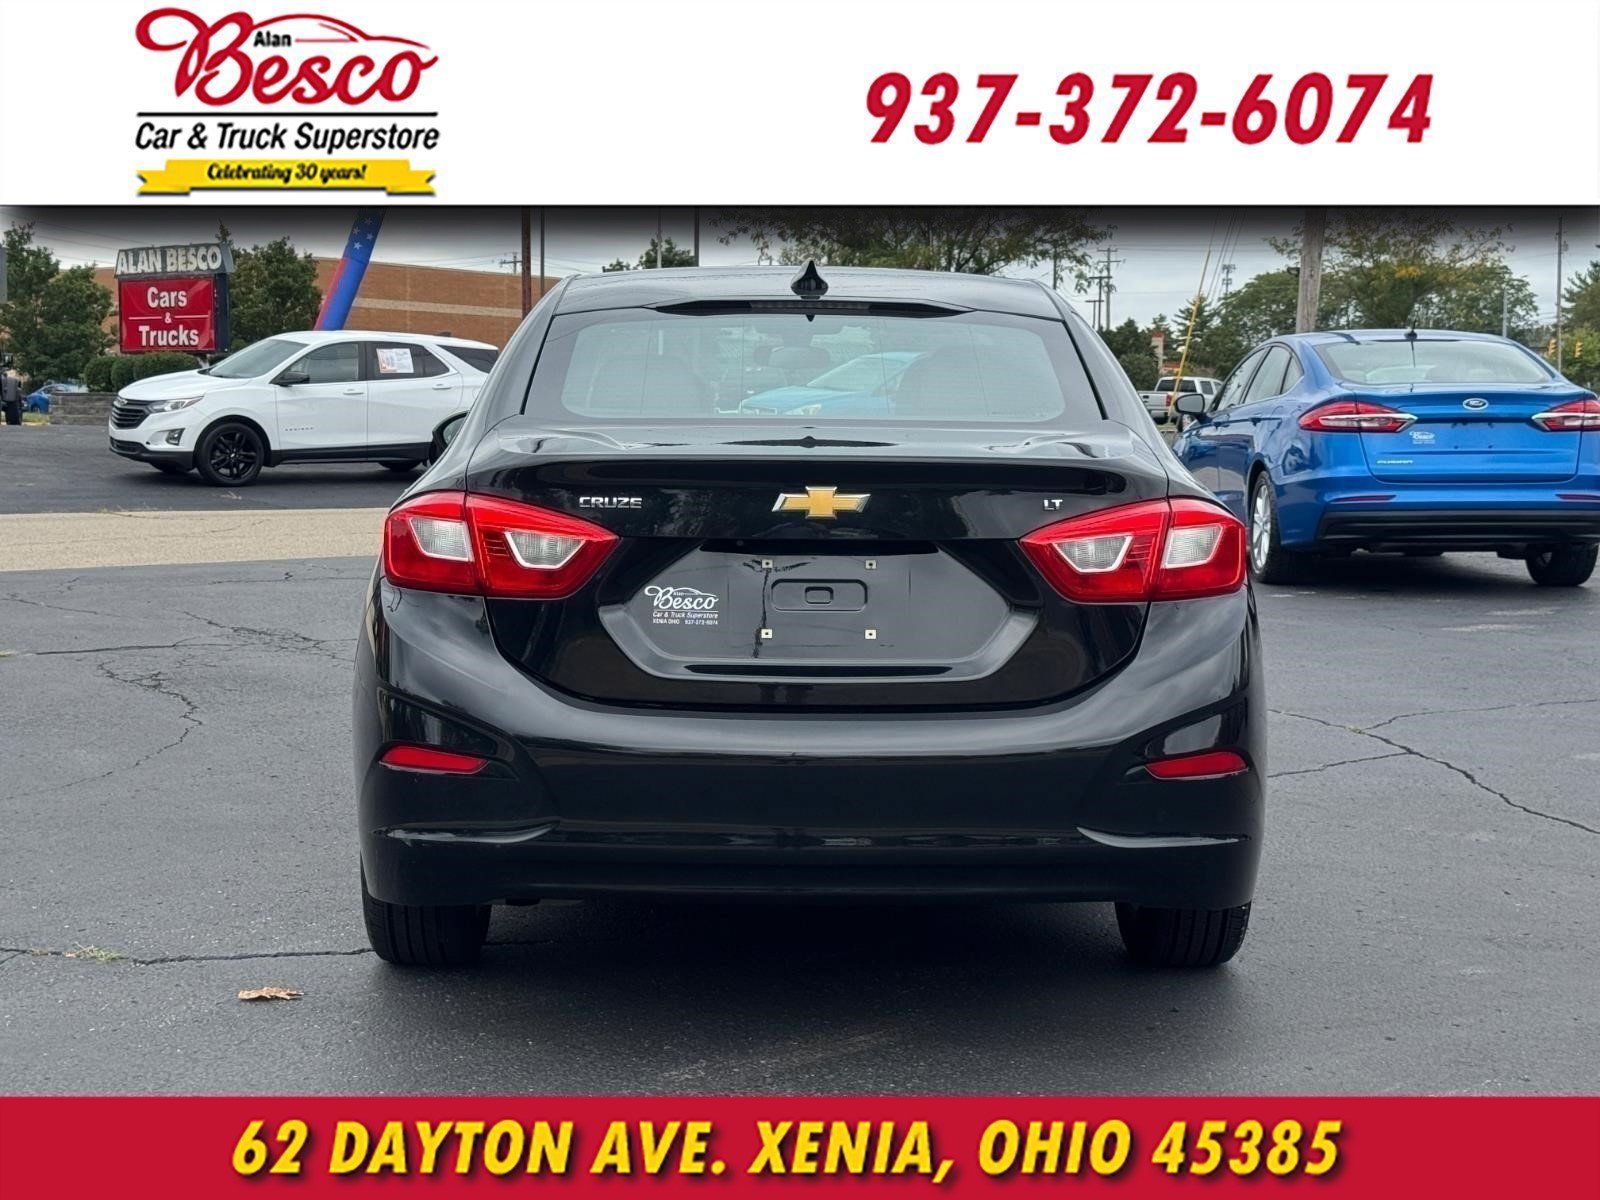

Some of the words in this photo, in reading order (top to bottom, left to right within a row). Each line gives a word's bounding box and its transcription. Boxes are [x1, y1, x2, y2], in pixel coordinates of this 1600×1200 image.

[116, 248, 162, 275] ALAN
[165, 246, 222, 272] BESCO
[147, 286, 188, 308] Cars
[164, 312, 172, 323] &
[138, 324, 200, 346] Trucks
[579, 496, 643, 509] CRUZE
[1043, 499, 1063, 510] LT
[644, 585, 719, 609] Besco
